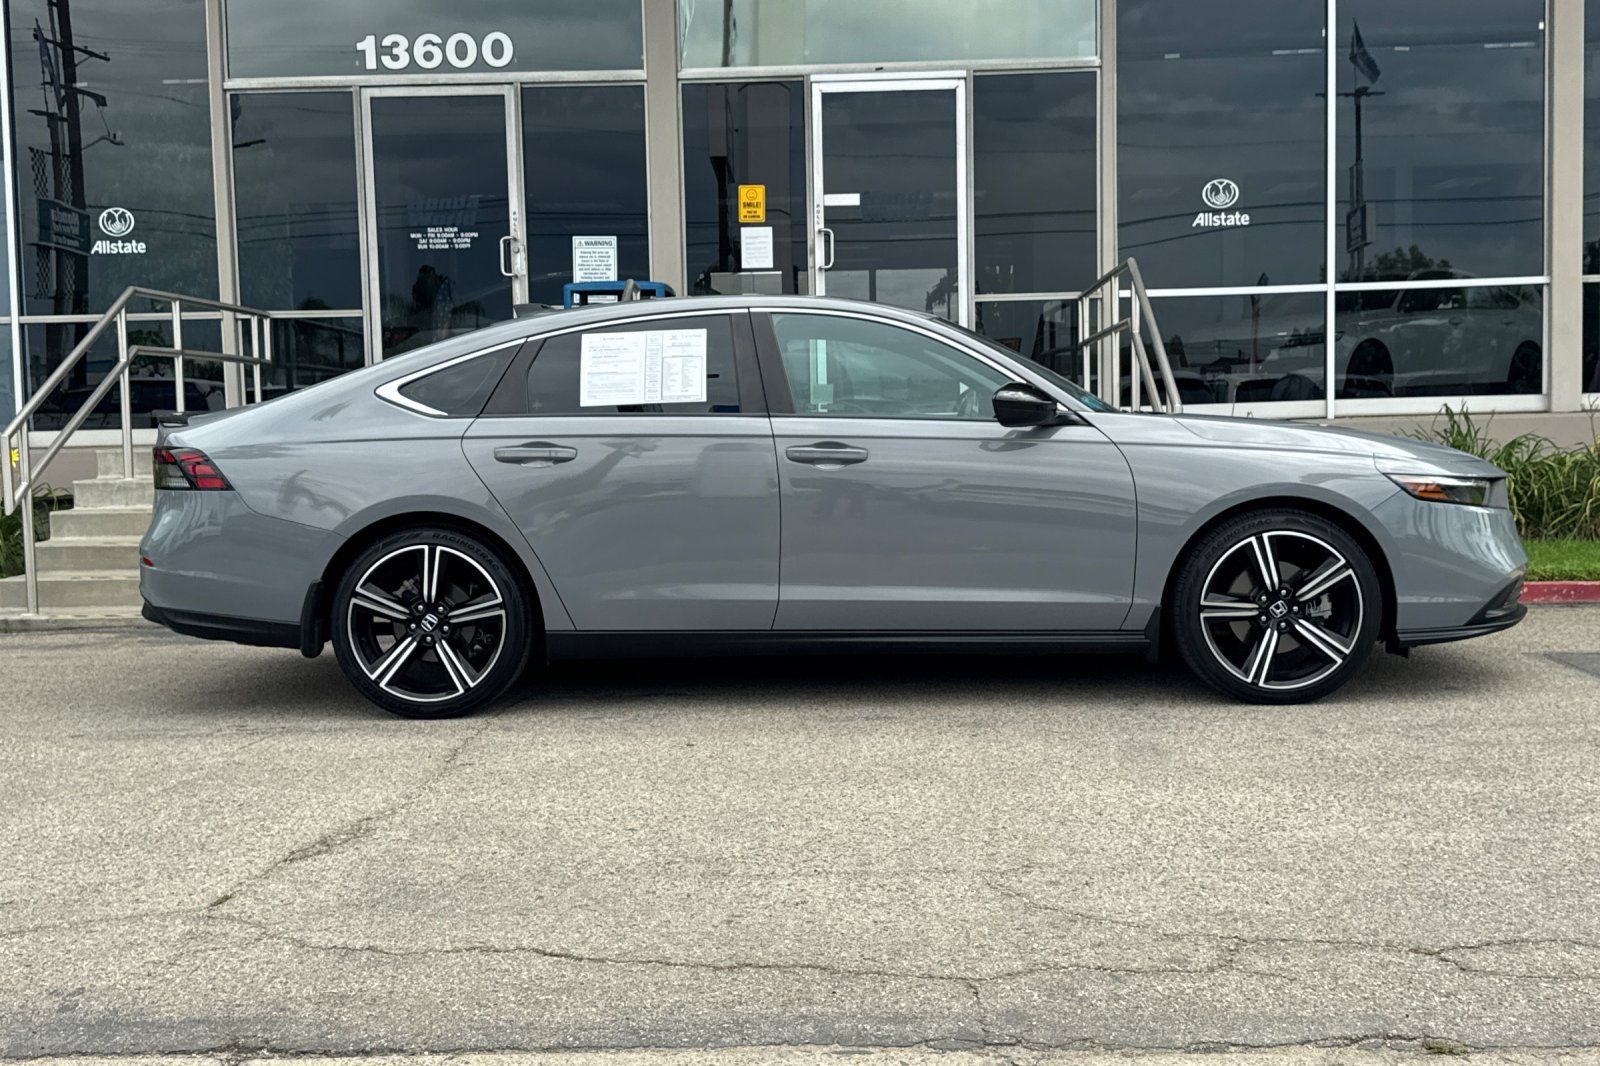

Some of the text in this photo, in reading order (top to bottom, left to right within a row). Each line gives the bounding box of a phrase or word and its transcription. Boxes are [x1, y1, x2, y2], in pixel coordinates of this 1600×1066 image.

[356, 31, 514, 70] 13600
[1192, 212, 1250, 227] Allstate
[90, 240, 146, 254] Allstate
